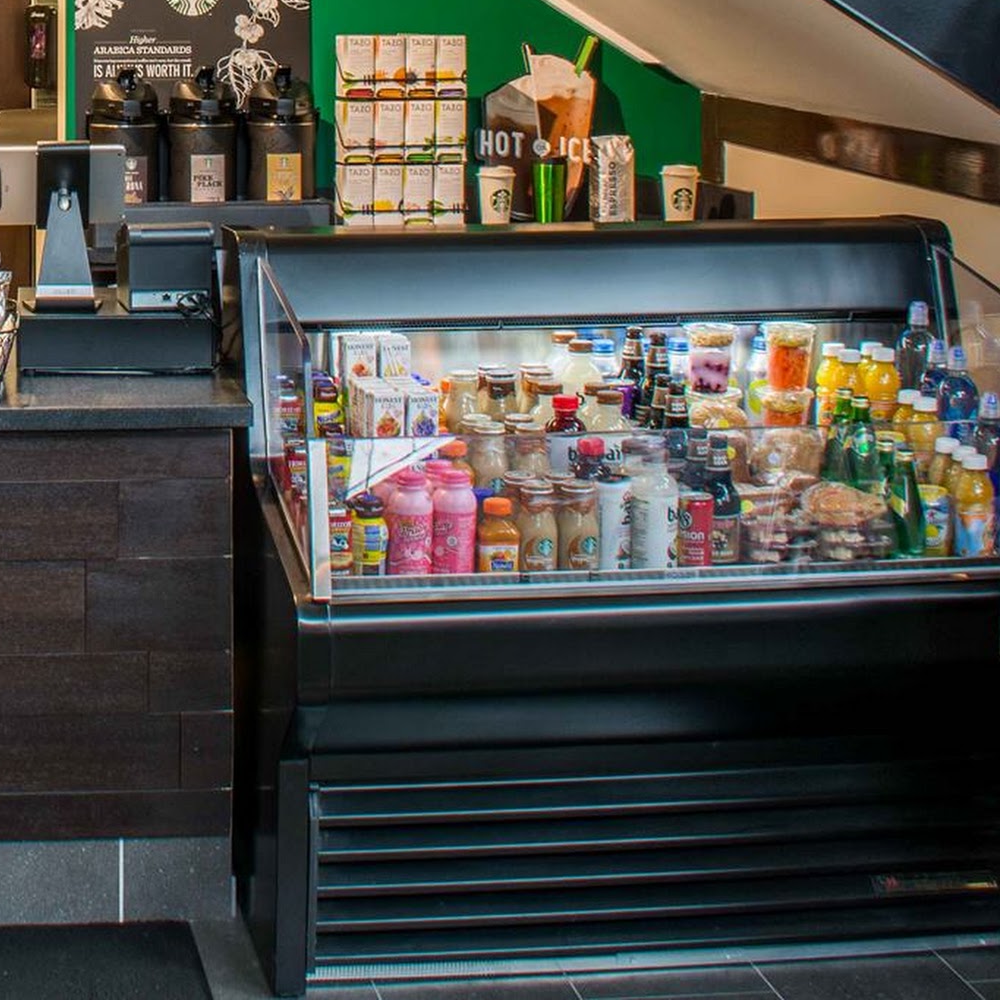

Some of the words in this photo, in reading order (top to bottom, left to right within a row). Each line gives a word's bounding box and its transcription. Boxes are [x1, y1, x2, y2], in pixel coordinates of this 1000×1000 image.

[128, 35, 157, 45] Higher
[350, 38, 371, 47] TAZO
[381, 38, 403, 47] TAZO
[412, 38, 433, 47] TAZO
[442, 38, 463, 47] TAZO
[93, 45, 135, 55] ARABICA
[136, 45, 192, 55] STANDARDS
[93, 64, 103, 78] IS
[145, 64, 180, 78] WORTH
[350, 103, 371, 113] TAZO
[380, 103, 401, 112] TAZO
[411, 103, 432, 112] TAZO
[441, 102, 463, 112] TAZO
[479, 129, 525, 159] HOT
[559, 136, 593, 164] ICE
[349, 168, 370, 177] TAZO
[379, 167, 401, 177] TAZO
[408, 168, 430, 177] TAZO
[439, 166, 460, 176] TAZO
